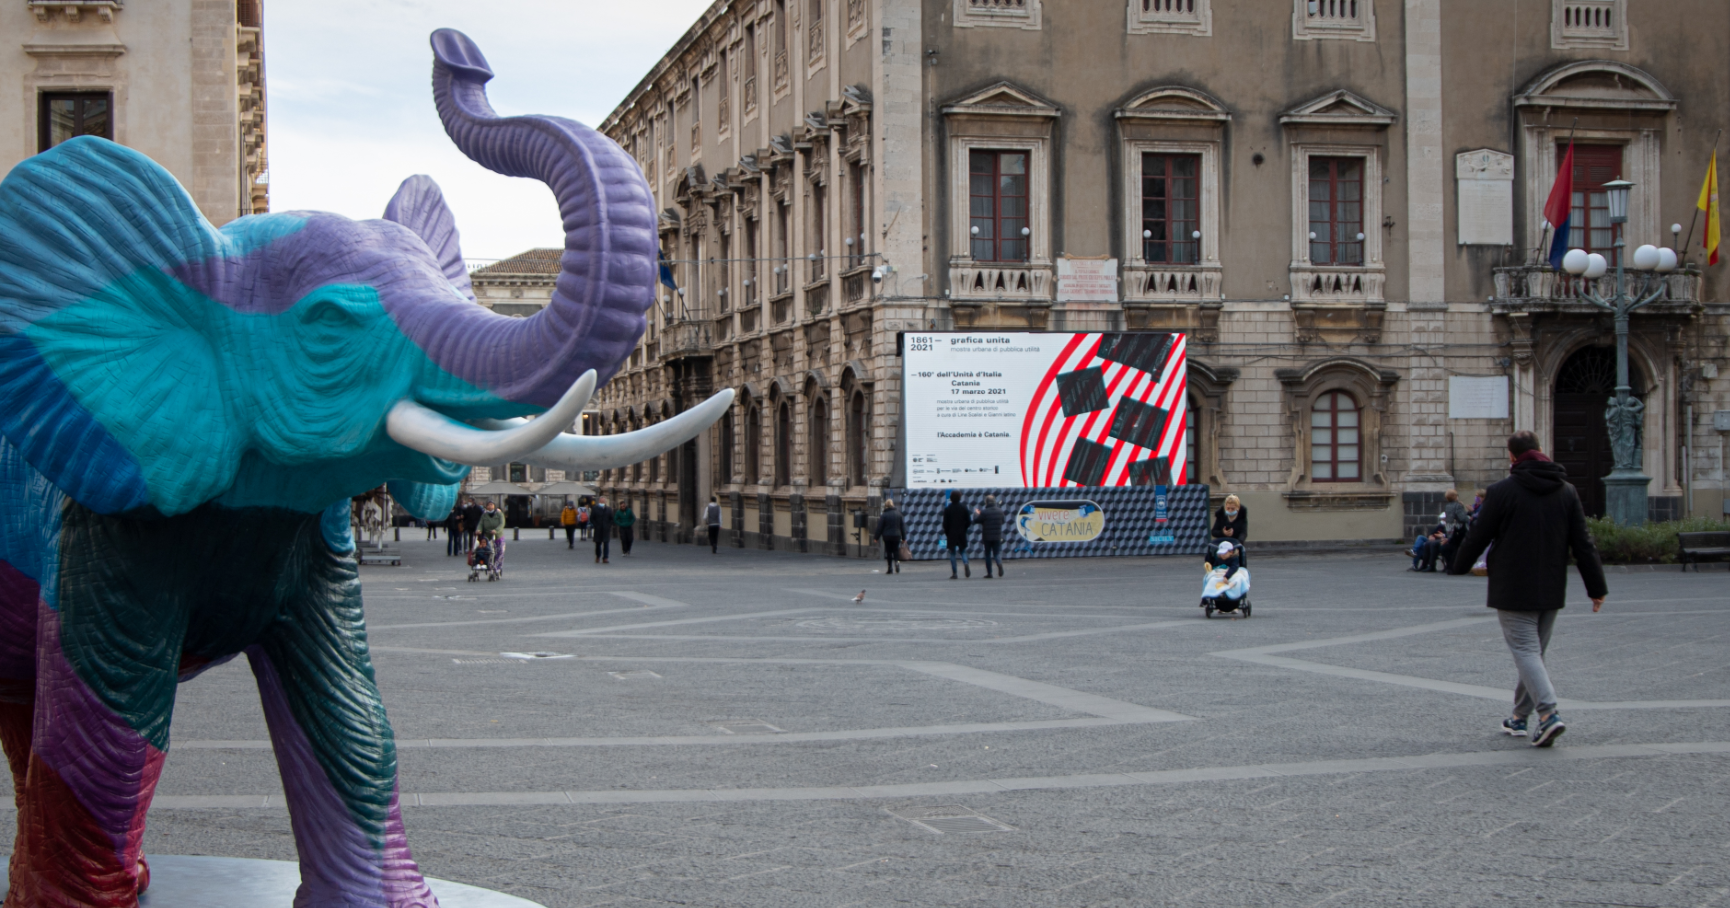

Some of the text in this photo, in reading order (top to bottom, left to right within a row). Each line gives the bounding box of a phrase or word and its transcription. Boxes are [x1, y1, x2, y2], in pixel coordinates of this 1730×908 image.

[950, 336, 983, 345] grafica
[986, 336, 1010, 344] unita
[1038, 509, 1070, 520] vivere
[1041, 522, 1093, 536] CATANIA
